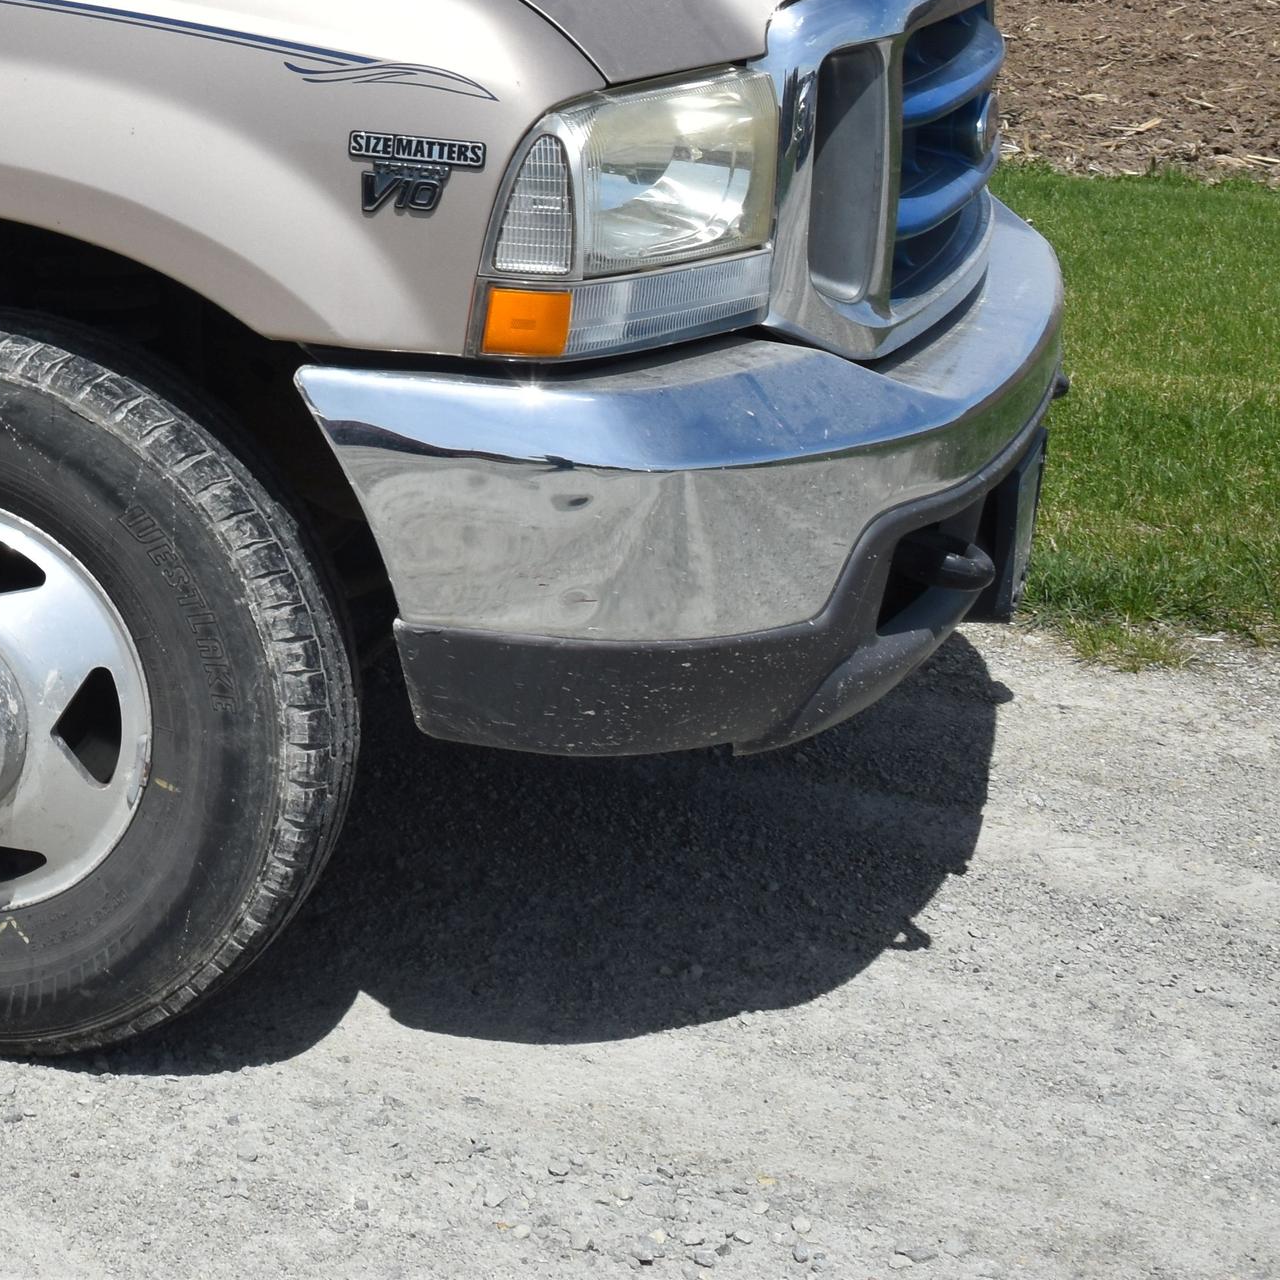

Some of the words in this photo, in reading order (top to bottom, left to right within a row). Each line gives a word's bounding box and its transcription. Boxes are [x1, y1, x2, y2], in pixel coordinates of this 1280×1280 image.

[350, 134, 393, 156] SIZE
[395, 136, 483, 164] MATTERS
[361, 170, 443, 213] V10
[117, 503, 237, 716] WESTLAKE
